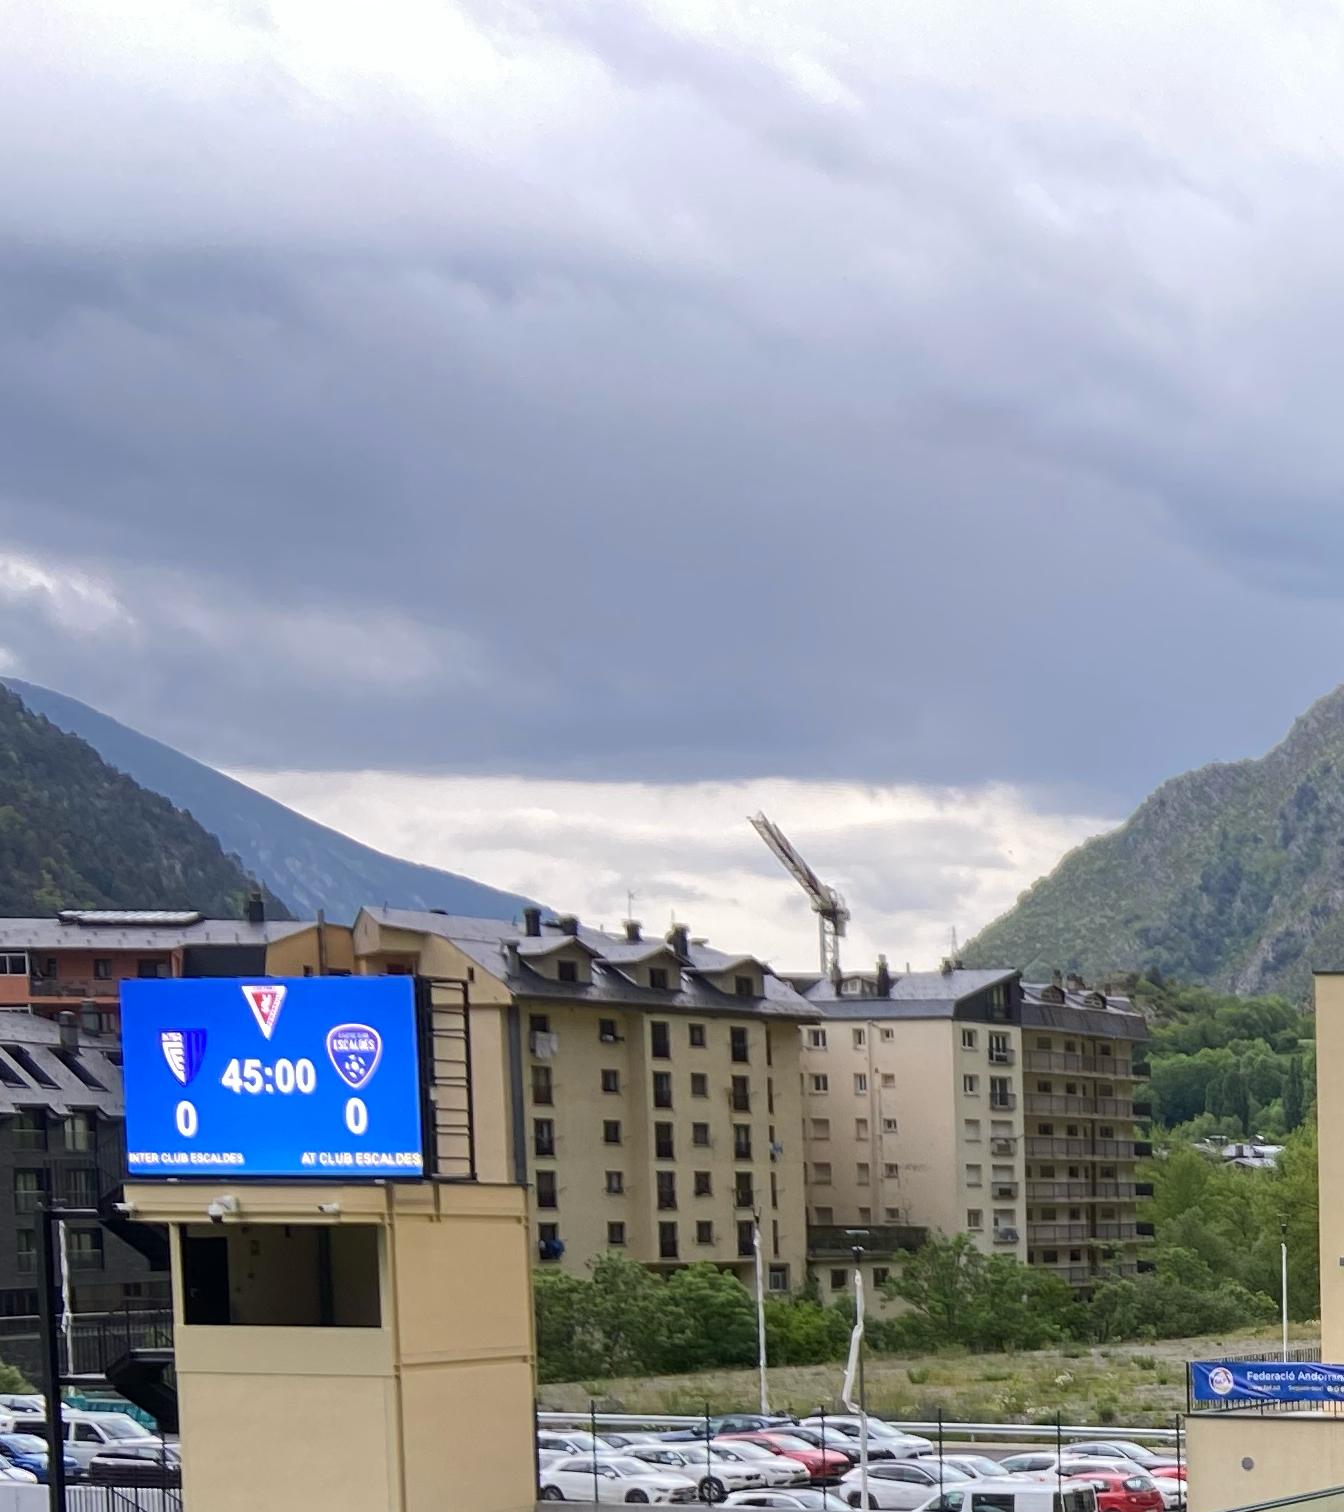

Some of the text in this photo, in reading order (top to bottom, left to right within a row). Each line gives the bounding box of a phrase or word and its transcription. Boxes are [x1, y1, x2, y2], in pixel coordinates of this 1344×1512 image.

[221, 1058, 317, 1094] 45:00
[175, 1100, 198, 1138] 0
[344, 1096, 368, 1136] 0
[128, 1152, 245, 1165] INTER CLUB ESCALDES
[302, 1152, 423, 1167] AT CLUB ESCALDES
[1246, 1370, 1296, 1381] Federació
